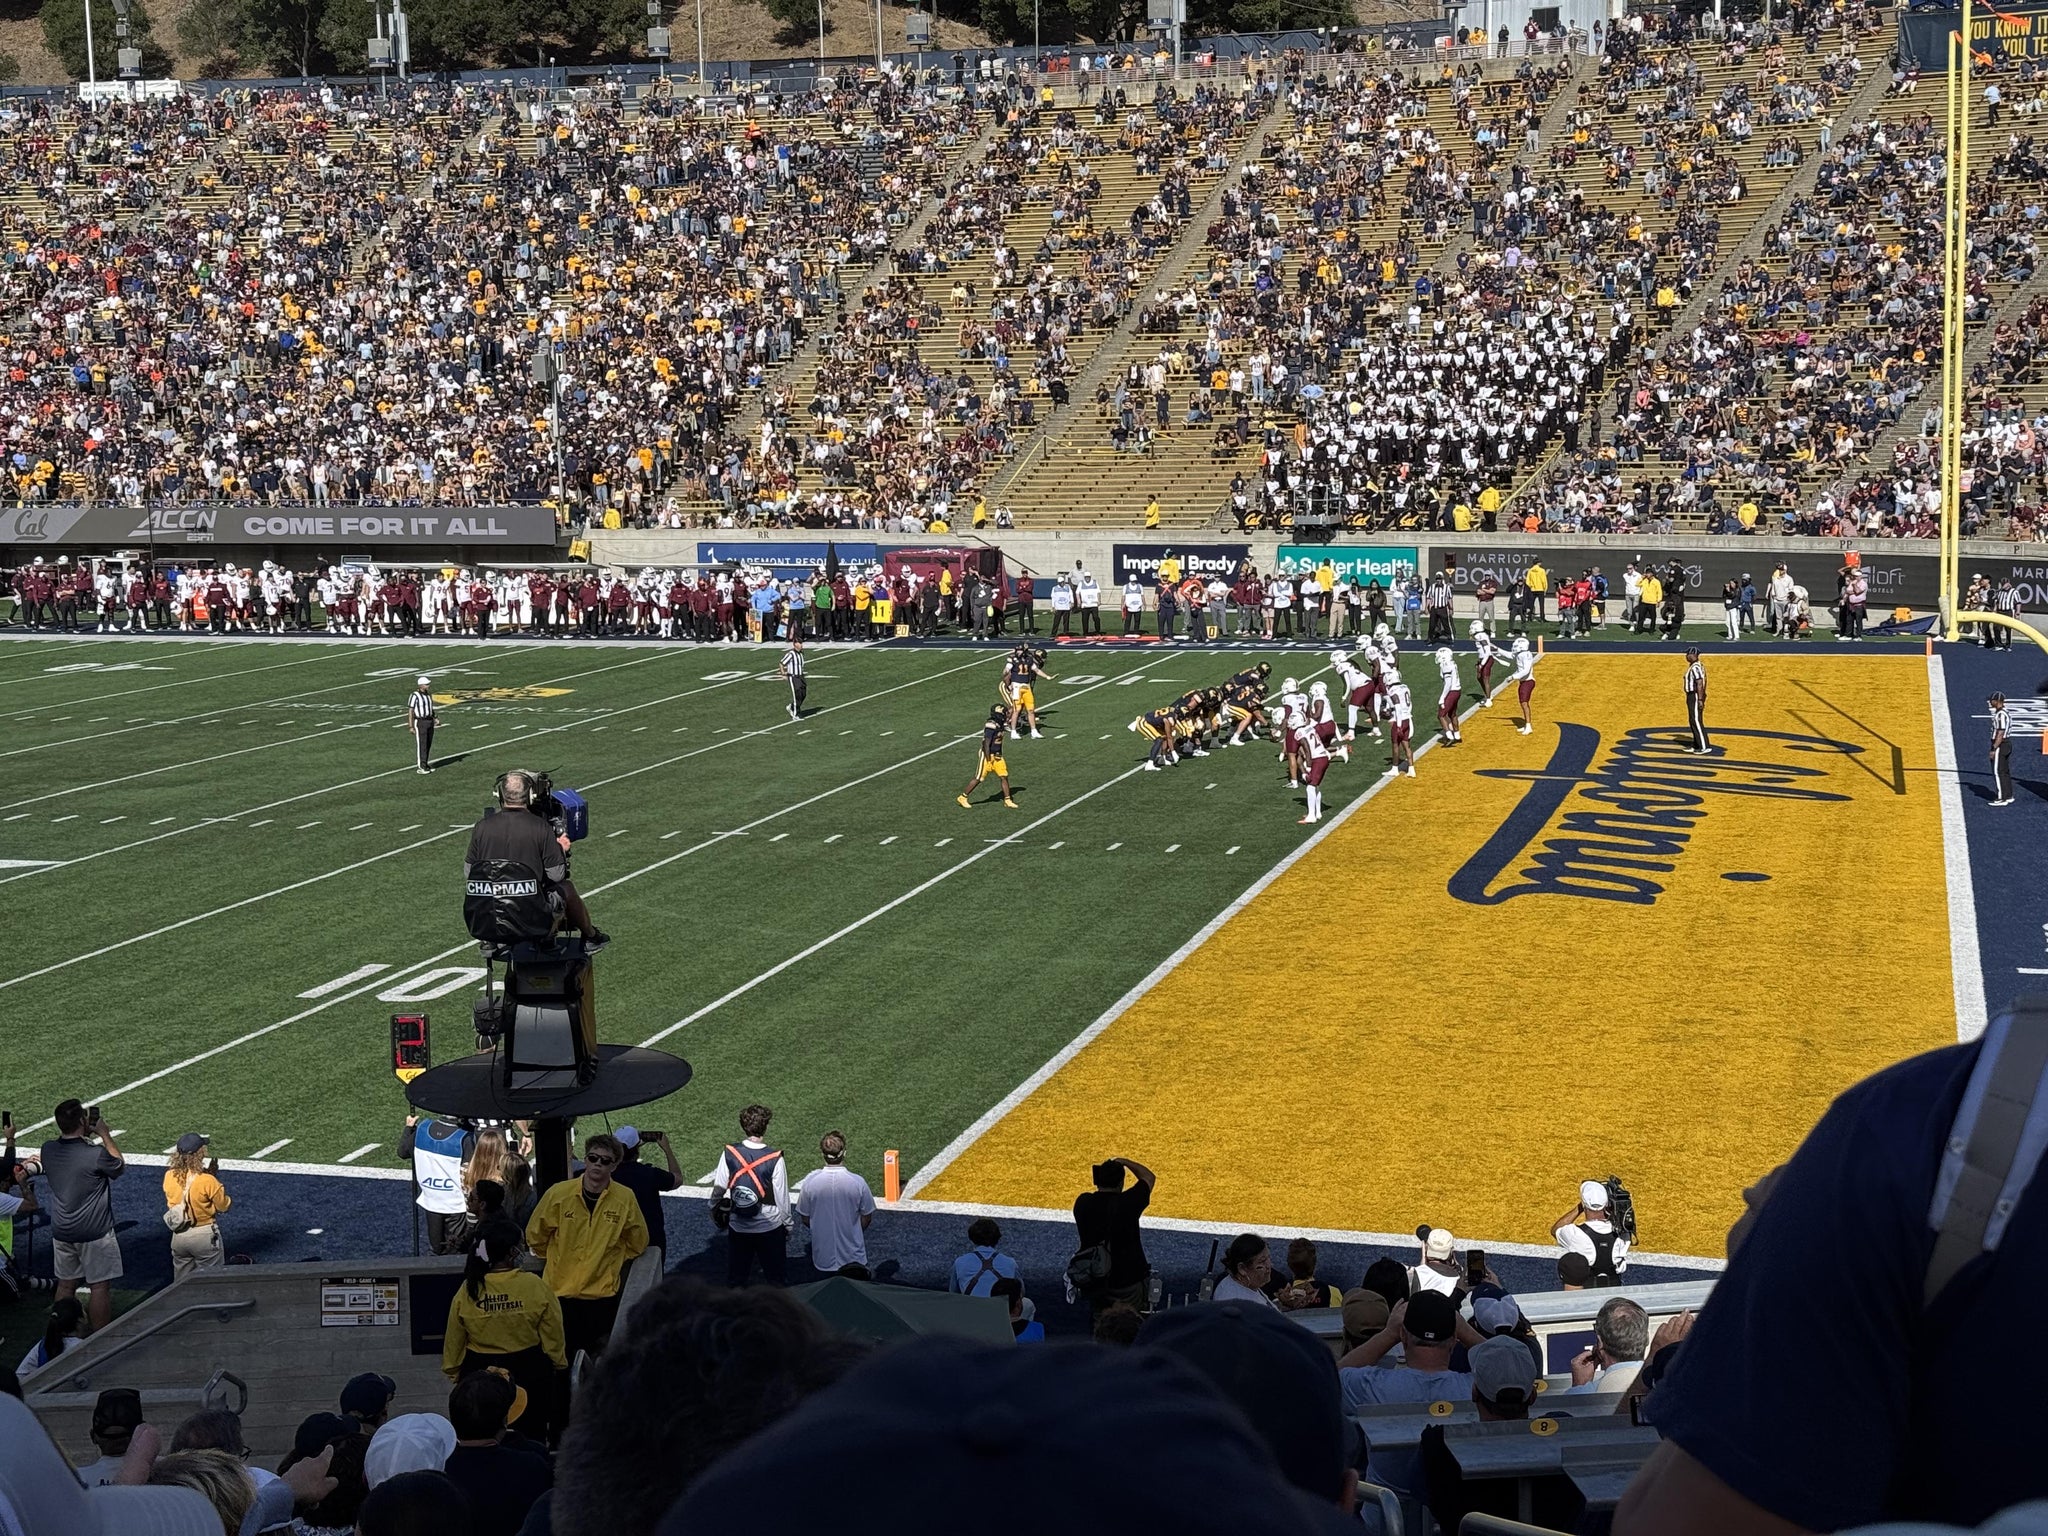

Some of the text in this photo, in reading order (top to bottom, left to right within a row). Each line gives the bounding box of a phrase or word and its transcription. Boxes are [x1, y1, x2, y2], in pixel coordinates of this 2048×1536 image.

[1995, 16, 2032, 38] KNOW
[2002, 37, 2027, 57] YOU
[14, 510, 48, 541] Cal
[136, 510, 217, 529] ACCN
[243, 517, 508, 536] COME FOR IT ALL
[757, 531, 770, 539] RR
[1839, 540, 1853, 549] PP
[1188, 555, 1237, 575] Brady
[2012, 566, 2048, 579] MAR
[1447, 721, 1866, 905] California
[467, 881, 536, 896] CHAPMAN
[421, 1176, 454, 1190] ACC
[484, 1293, 509, 1302] ALLIED
[484, 1301, 524, 1312] UNIVERSAL
[1437, 1404, 1445, 1414] 8
[1540, 1421, 1549, 1432] 8
